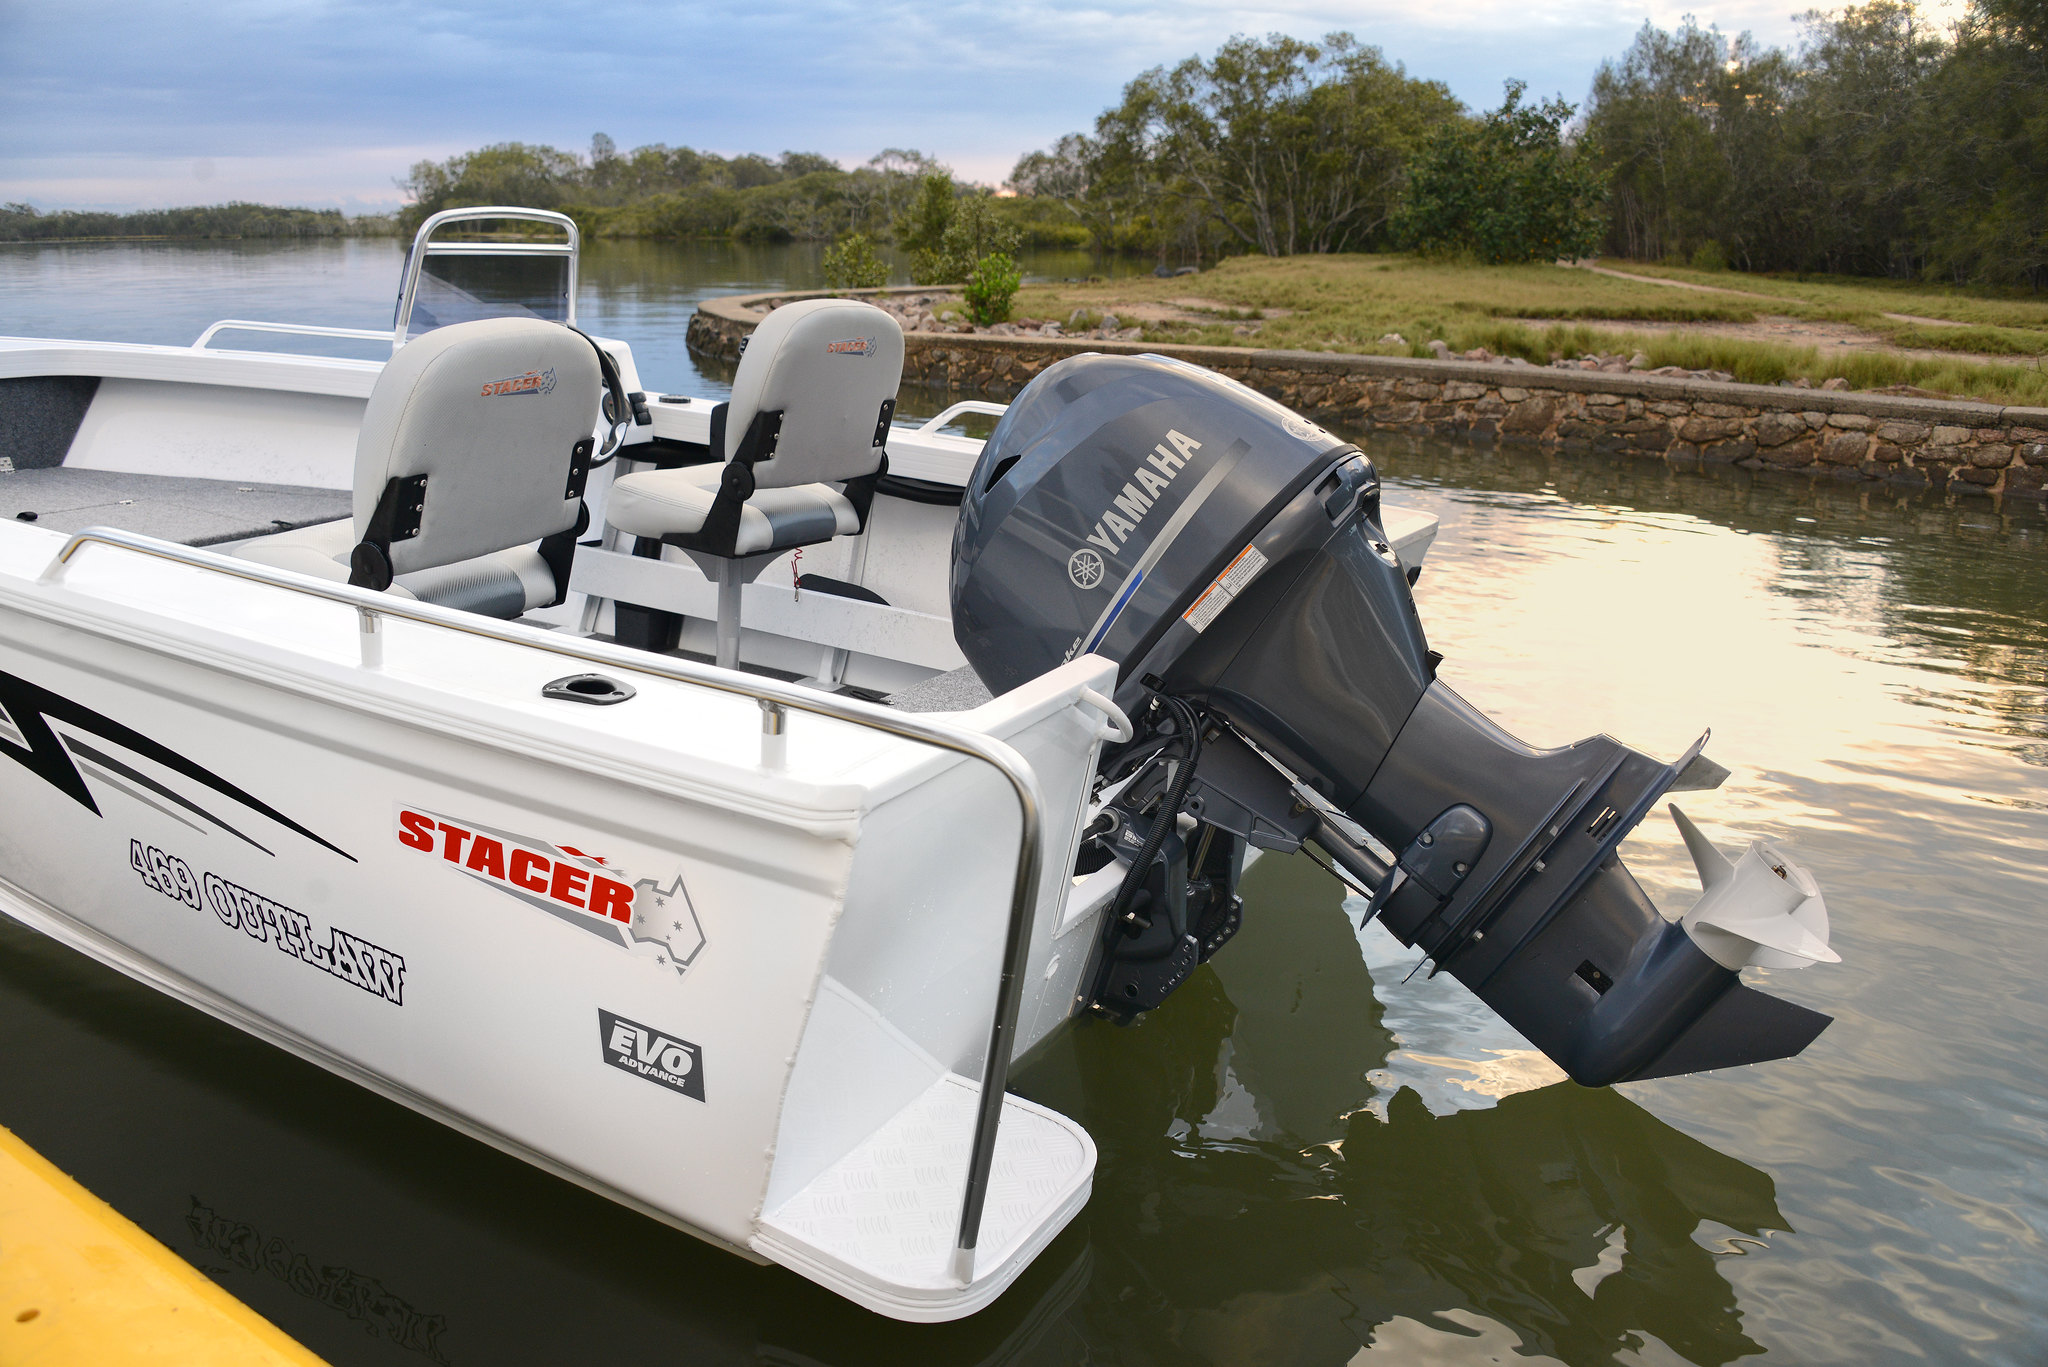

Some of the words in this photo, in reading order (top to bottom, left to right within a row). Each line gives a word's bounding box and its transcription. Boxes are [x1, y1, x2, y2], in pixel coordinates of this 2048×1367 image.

[826, 341, 867, 352] STACER
[481, 376, 542, 397] STACER
[1086, 429, 1202, 555] YAMAHA
[398, 810, 635, 924] STACER
[130, 838, 202, 911] 469
[203, 871, 406, 1006] OUTLAW
[609, 1020, 694, 1076] EVO
[618, 1055, 686, 1087] ADVANCE
